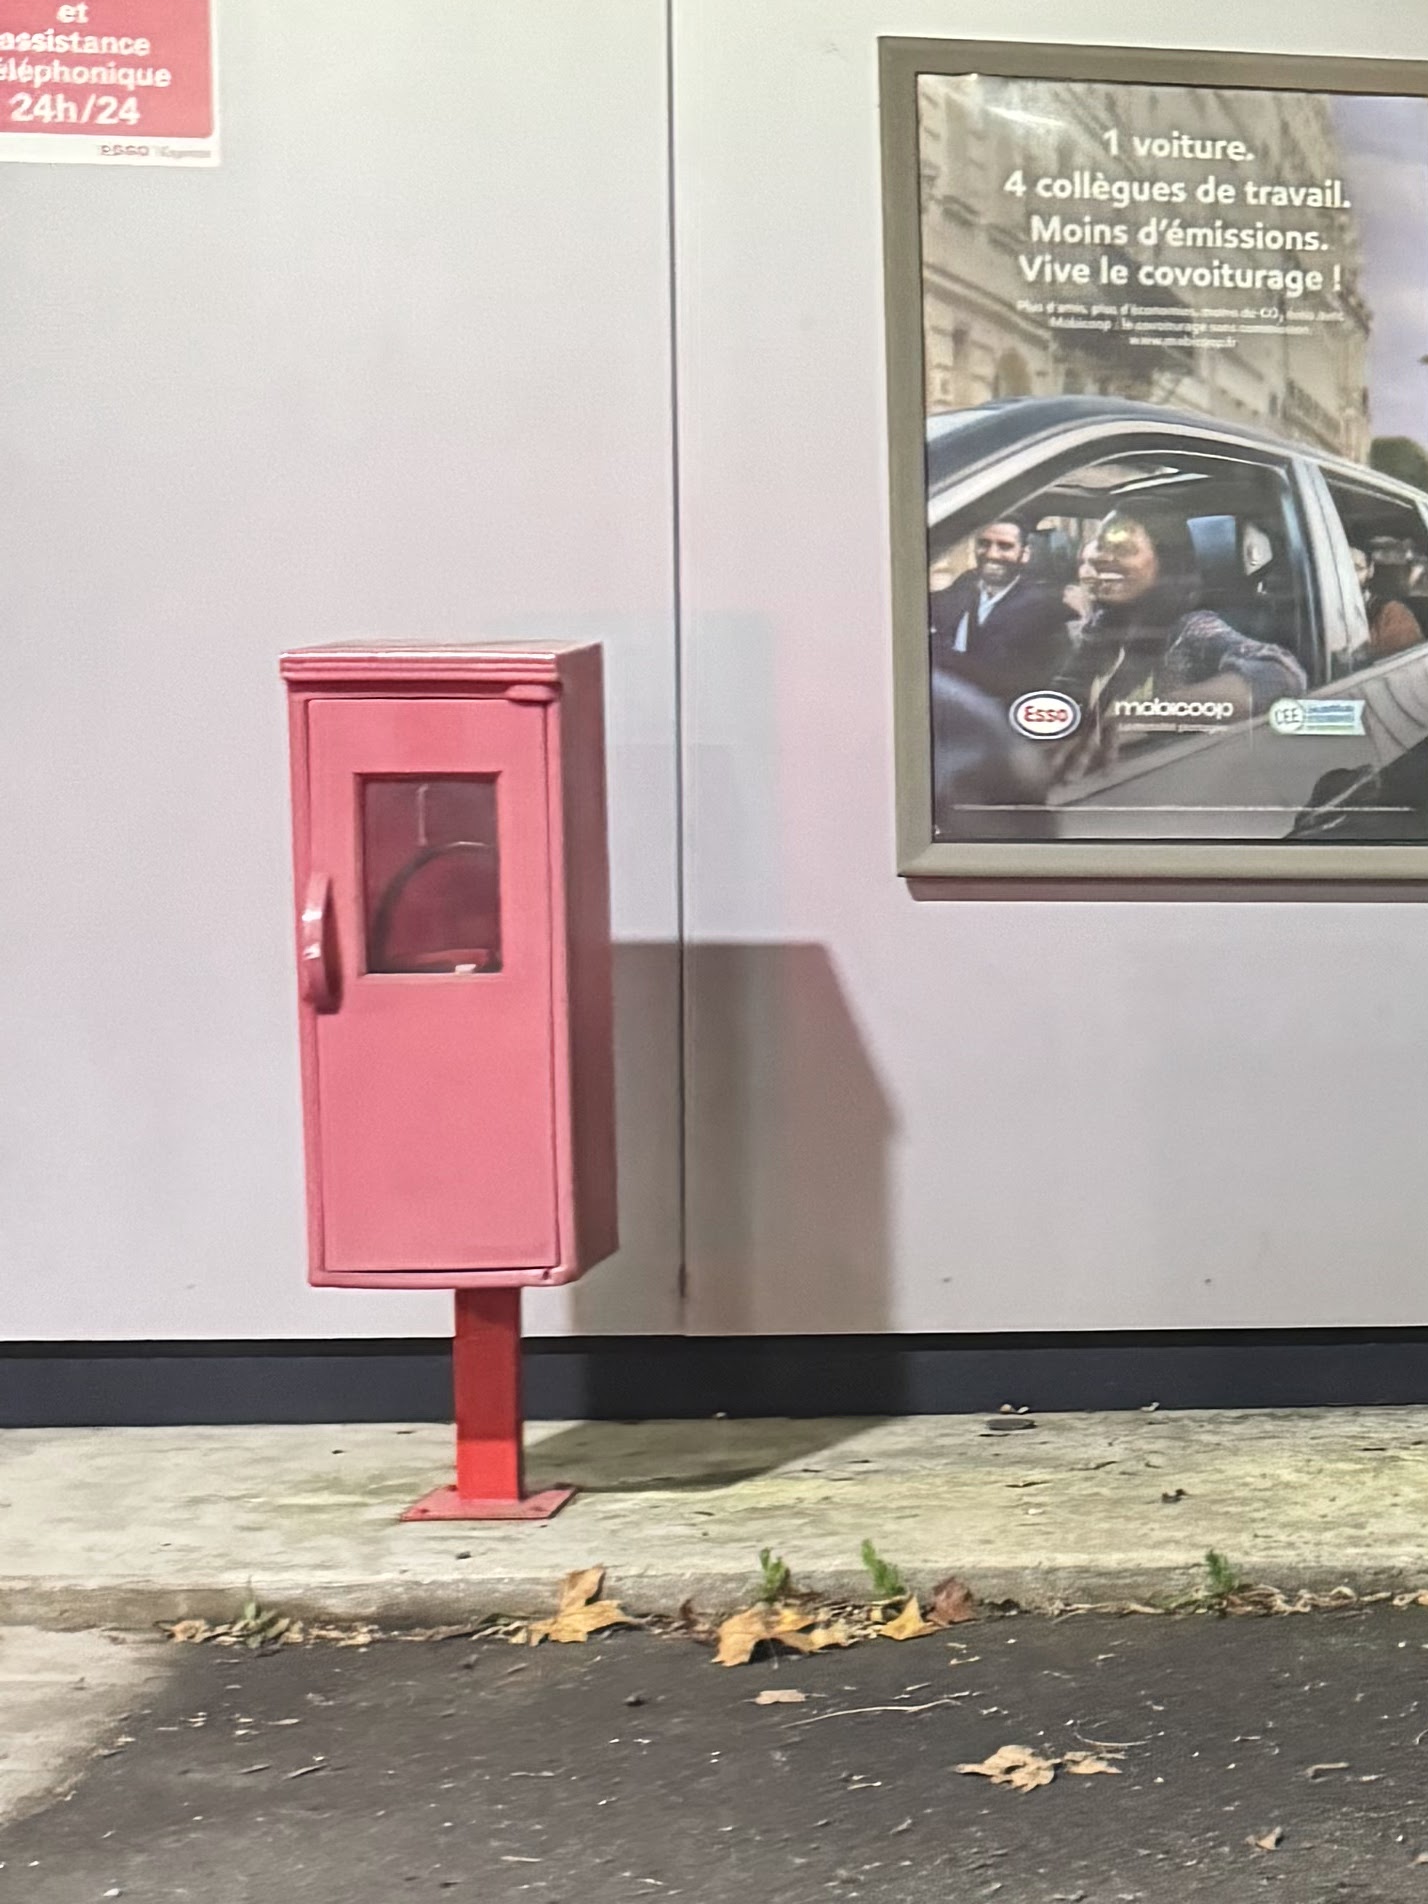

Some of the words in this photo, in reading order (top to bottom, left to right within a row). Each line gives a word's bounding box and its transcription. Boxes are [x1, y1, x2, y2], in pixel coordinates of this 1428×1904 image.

[56, 2, 88, 23] et
[0, 28, 151, 56] assistance
[10, 92, 140, 125] 24h/24
[1103, 128, 1119, 156] 1
[1133, 130, 1255, 161] voiture.
[1003, 169, 1027, 197] 4
[1036, 170, 1187, 208] collègues
[1196, 175, 1236, 204] de
[1245, 179, 1351, 208] travail.
[1030, 214, 1128, 245] Moins
[1137, 217, 1329, 251] d'émissions.
[1019, 254, 1090, 284] Vive
[1100, 255, 1129, 284] le
[1137, 259, 1323, 298] covoiturage
[1024, 705, 1069, 723] Esso
